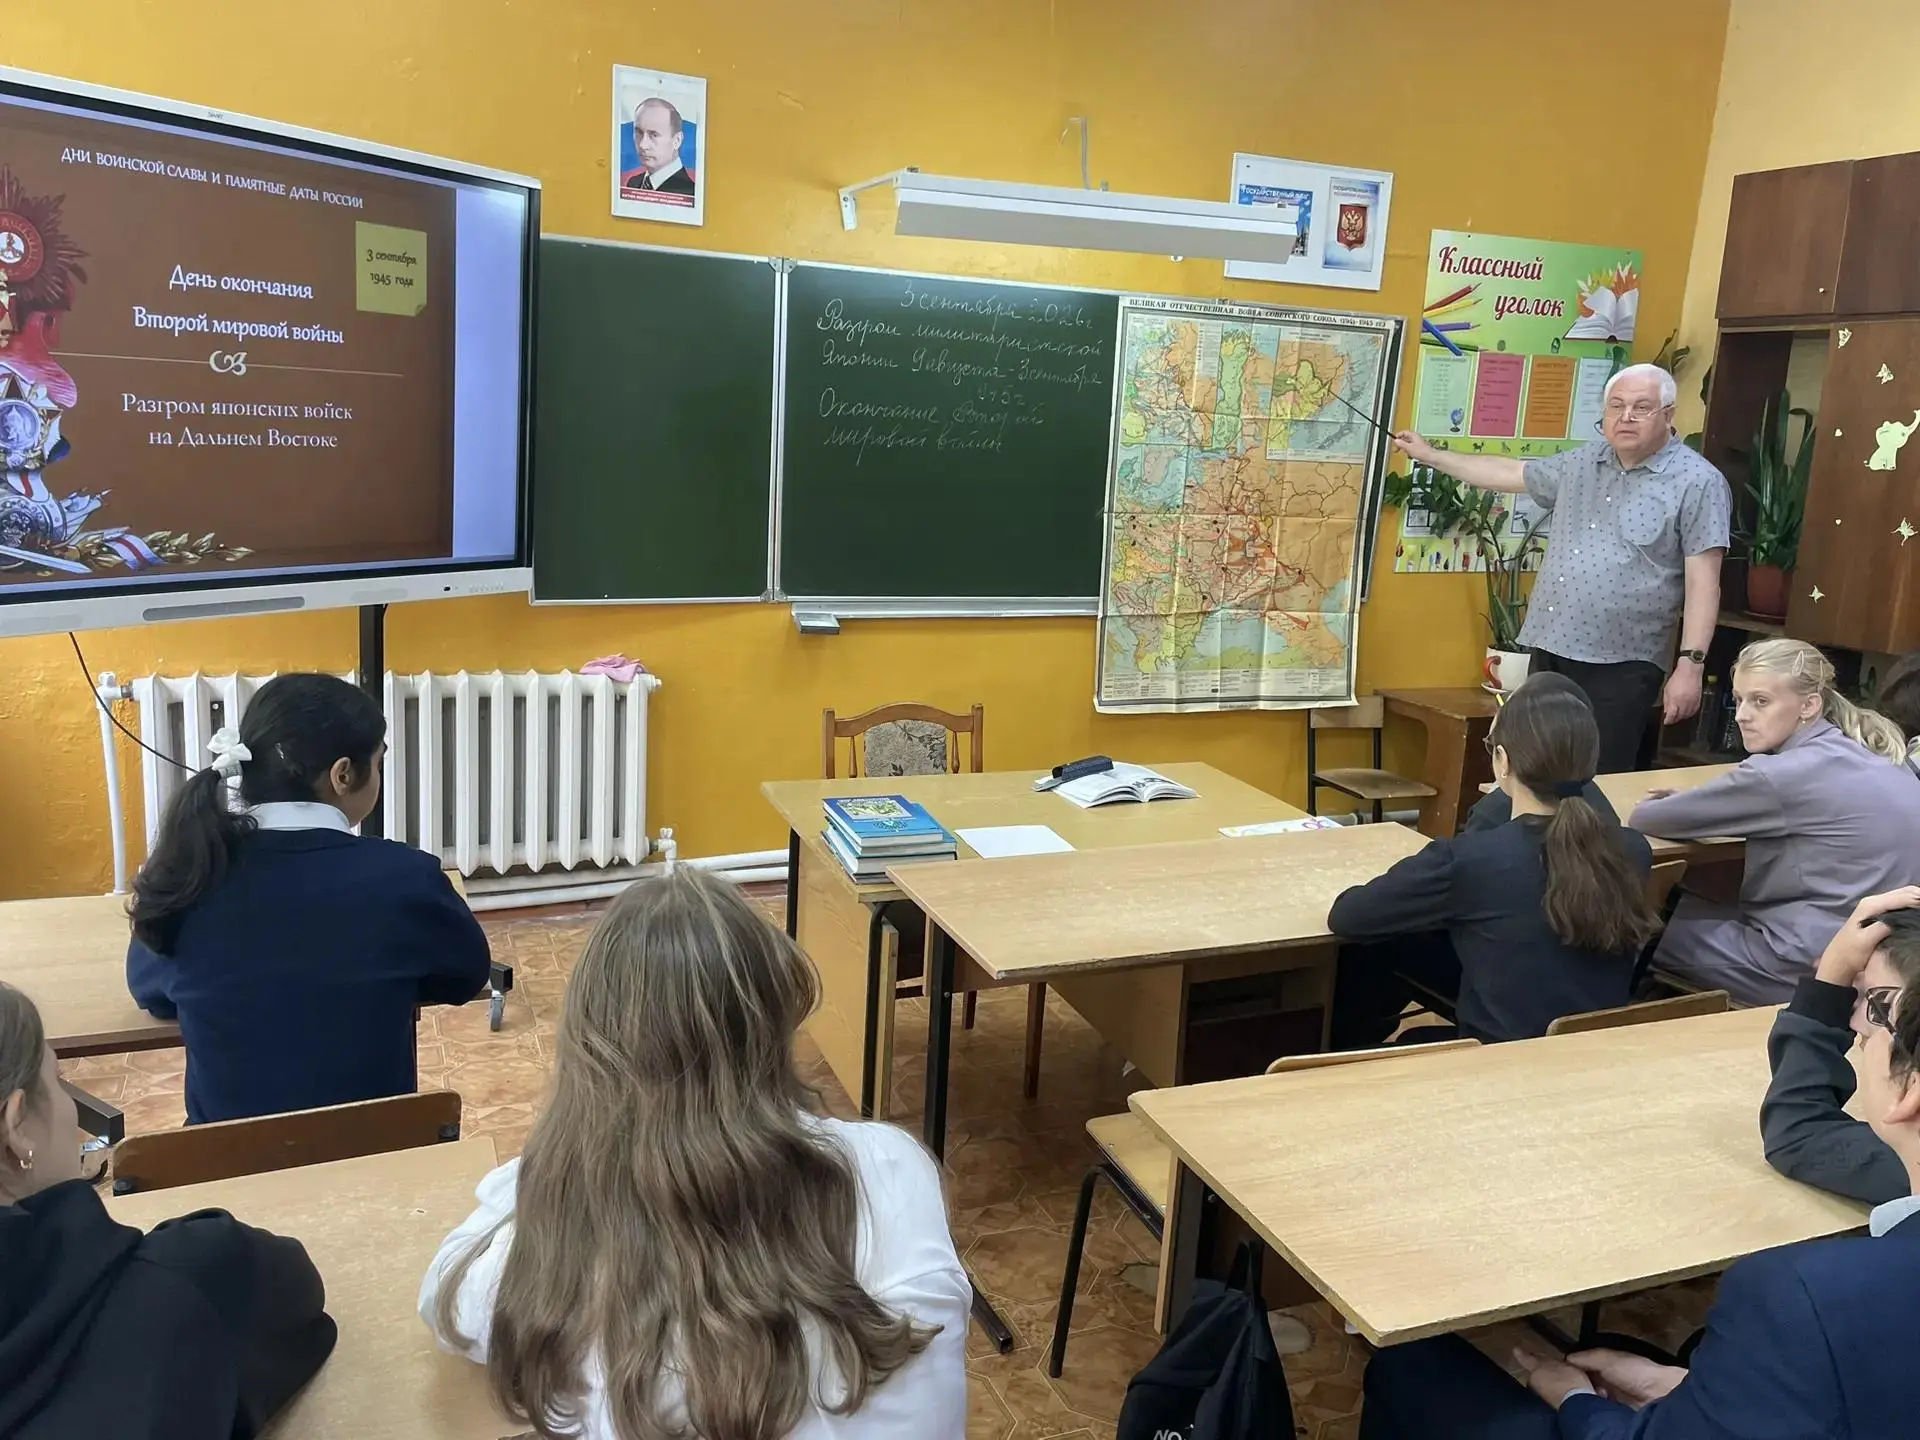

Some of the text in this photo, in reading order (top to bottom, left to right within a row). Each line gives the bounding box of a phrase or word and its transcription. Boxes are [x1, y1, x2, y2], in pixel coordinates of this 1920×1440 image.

[61, 148, 363, 208] ДНИ ВОИНСКОЙ СЛАВЫ И ПАМЯТНЫЕ ДАТЫ РОССИИ
[366, 248, 417, 268] 3 сентября
[1438, 246, 1544, 280] Классный
[169, 263, 314, 299] День окончания
[370, 272, 414, 288] 1945 года
[817, 298, 901, 347] Разгром
[1129, 299, 1166, 308] ВЕЛИКАЯ
[1170, 303, 1234, 314] ОТЕЧЕСТВЕННАЯ
[1238, 308, 1262, 317] ВОЙНА
[1265, 310, 1310, 321] СОВЕТСКОГО
[1313, 315, 1337, 323] СОЮЗА
[1494, 295, 1564, 321] уголок
[132, 306, 344, 344] Второй мировой войны
[822, 339, 898, 368] Японии
[121, 393, 353, 419] Разгром японских войск
[819, 387, 940, 423] Окончание
[149, 426, 338, 447] на Дальнем Востоке
[824, 423, 1002, 467] мировой войны
